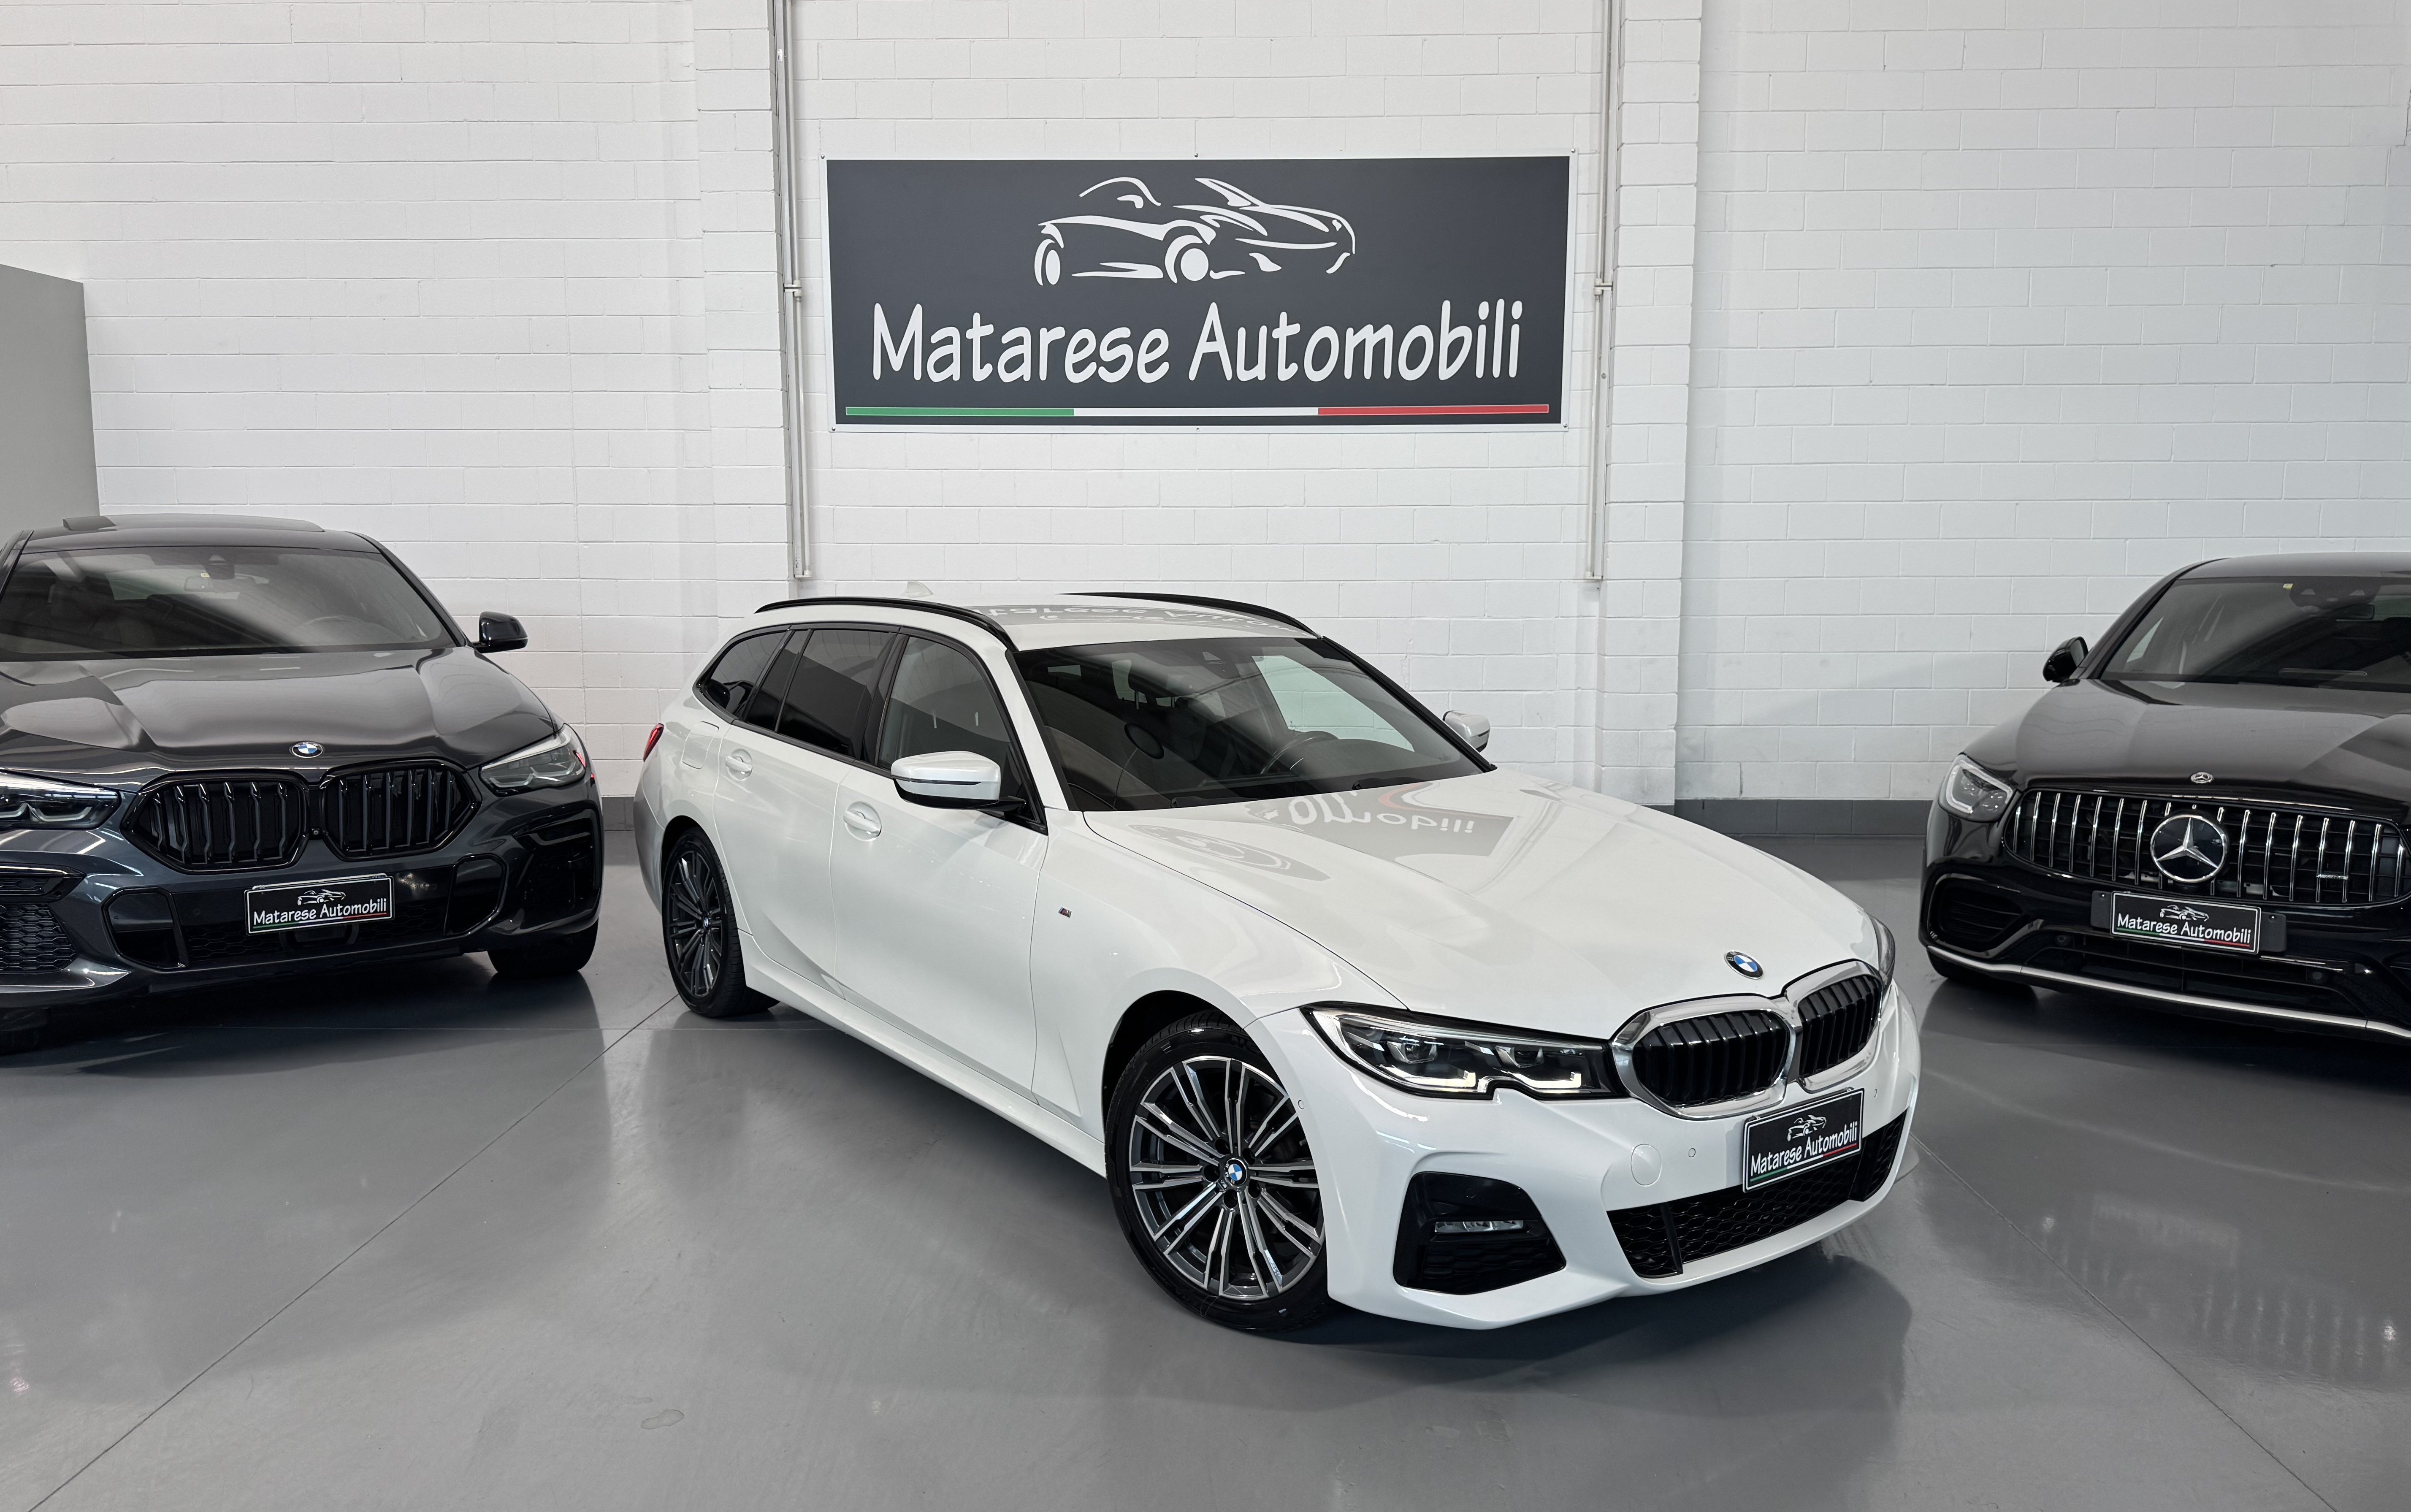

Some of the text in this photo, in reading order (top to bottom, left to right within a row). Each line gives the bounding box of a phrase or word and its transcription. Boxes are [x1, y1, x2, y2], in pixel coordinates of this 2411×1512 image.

[873, 298, 1523, 383] Matarese Automobili
[254, 898, 387, 925] Matarese Automobili
[2117, 913, 2251, 944] Matarese Automobili
[1751, 1121, 1858, 1176] Matarese Automobili
